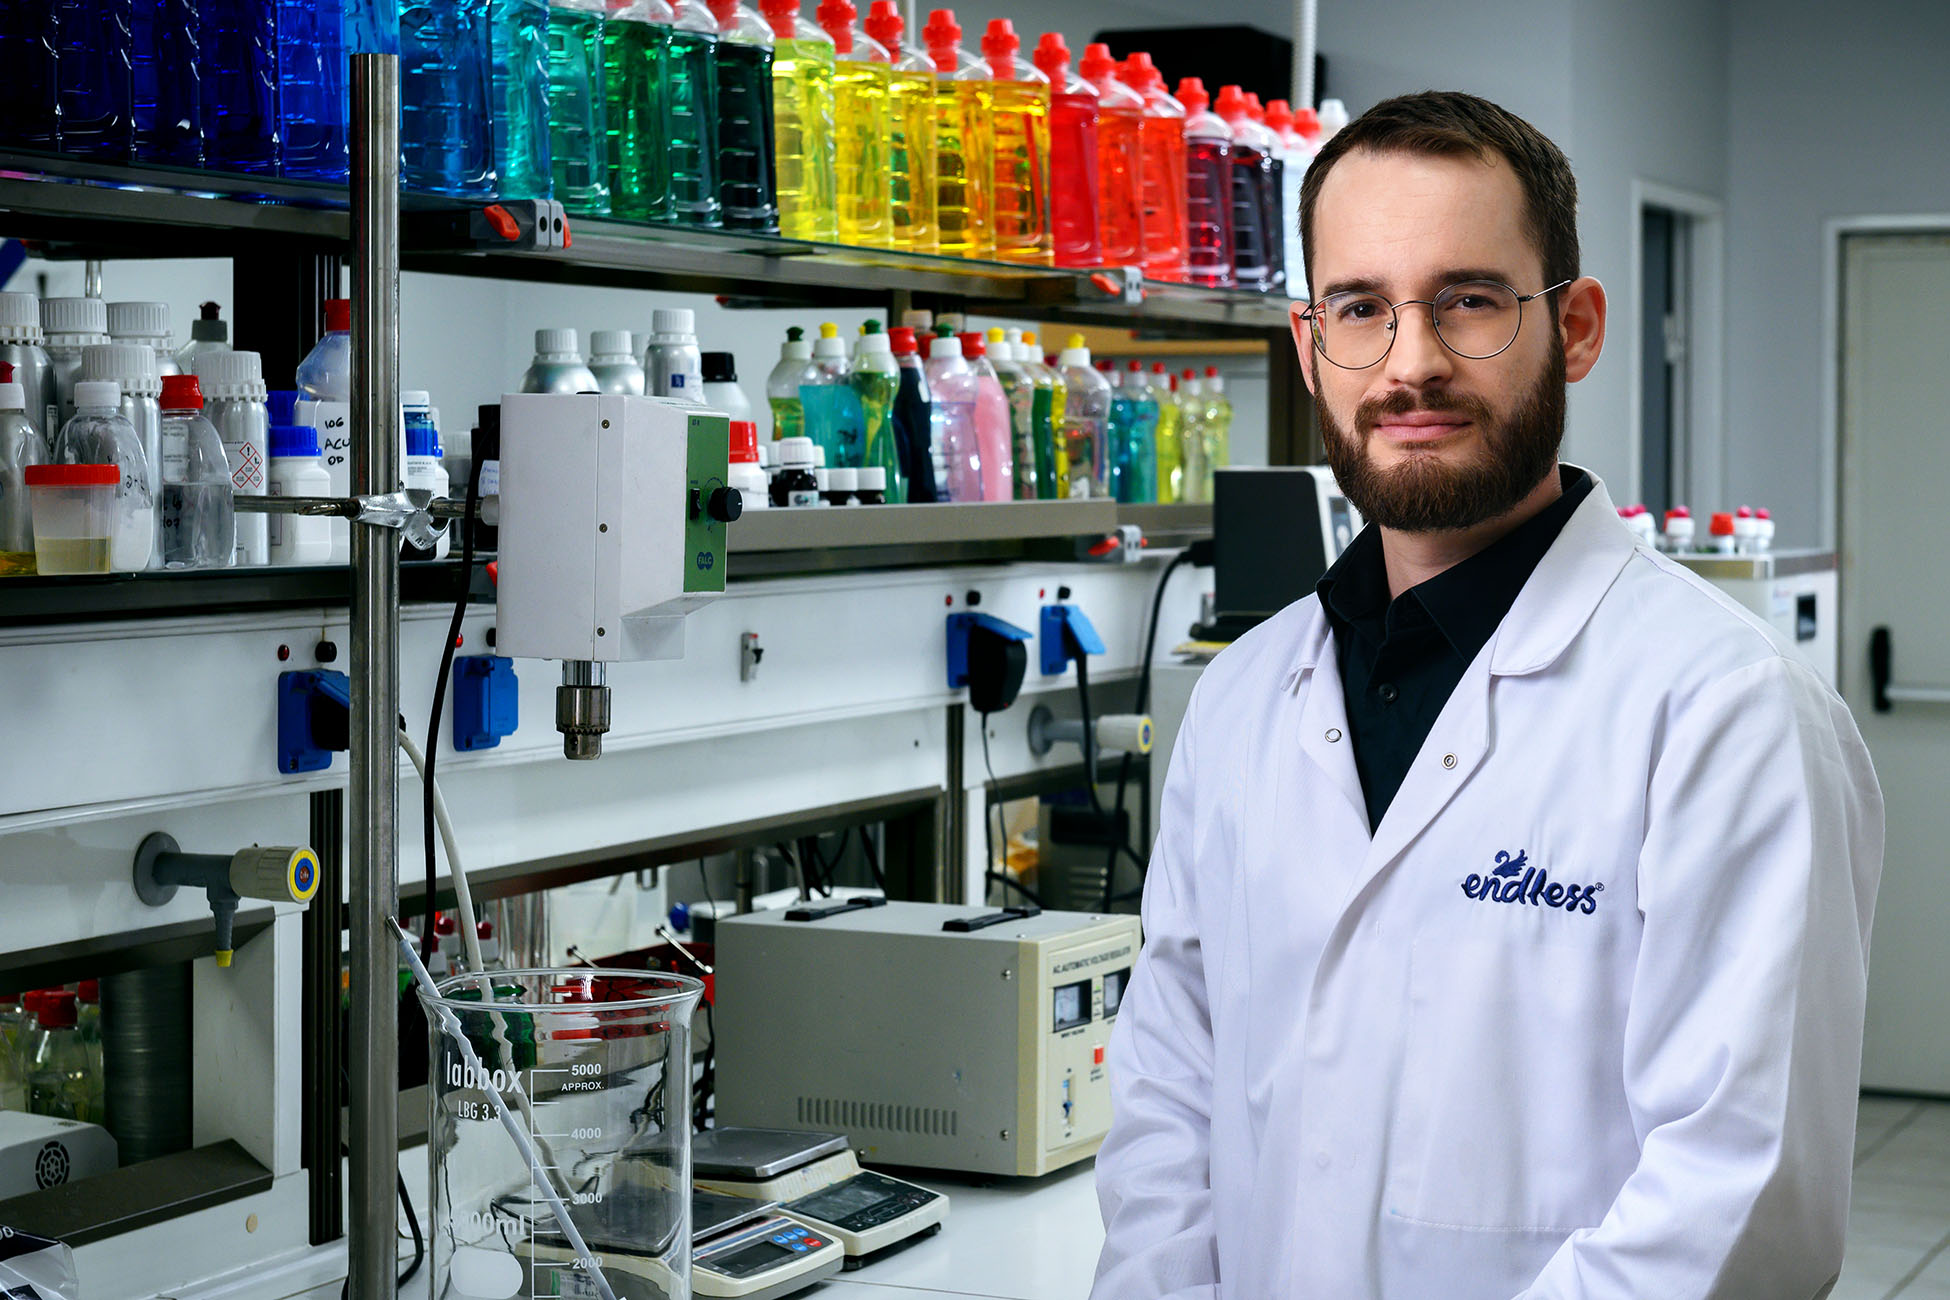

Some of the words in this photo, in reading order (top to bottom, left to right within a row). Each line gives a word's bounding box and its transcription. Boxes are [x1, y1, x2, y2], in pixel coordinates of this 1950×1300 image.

[1461, 866, 1597, 915] endless
[446, 1051, 523, 1093] labbox
[571, 1063, 602, 1076] 5000
[561, 1081, 605, 1091] APPROX.
[458, 1100, 478, 1119] LBG
[571, 1127, 602, 1140] 4000
[572, 1192, 602, 1205] 3000
[572, 1256, 603, 1270] 2000
